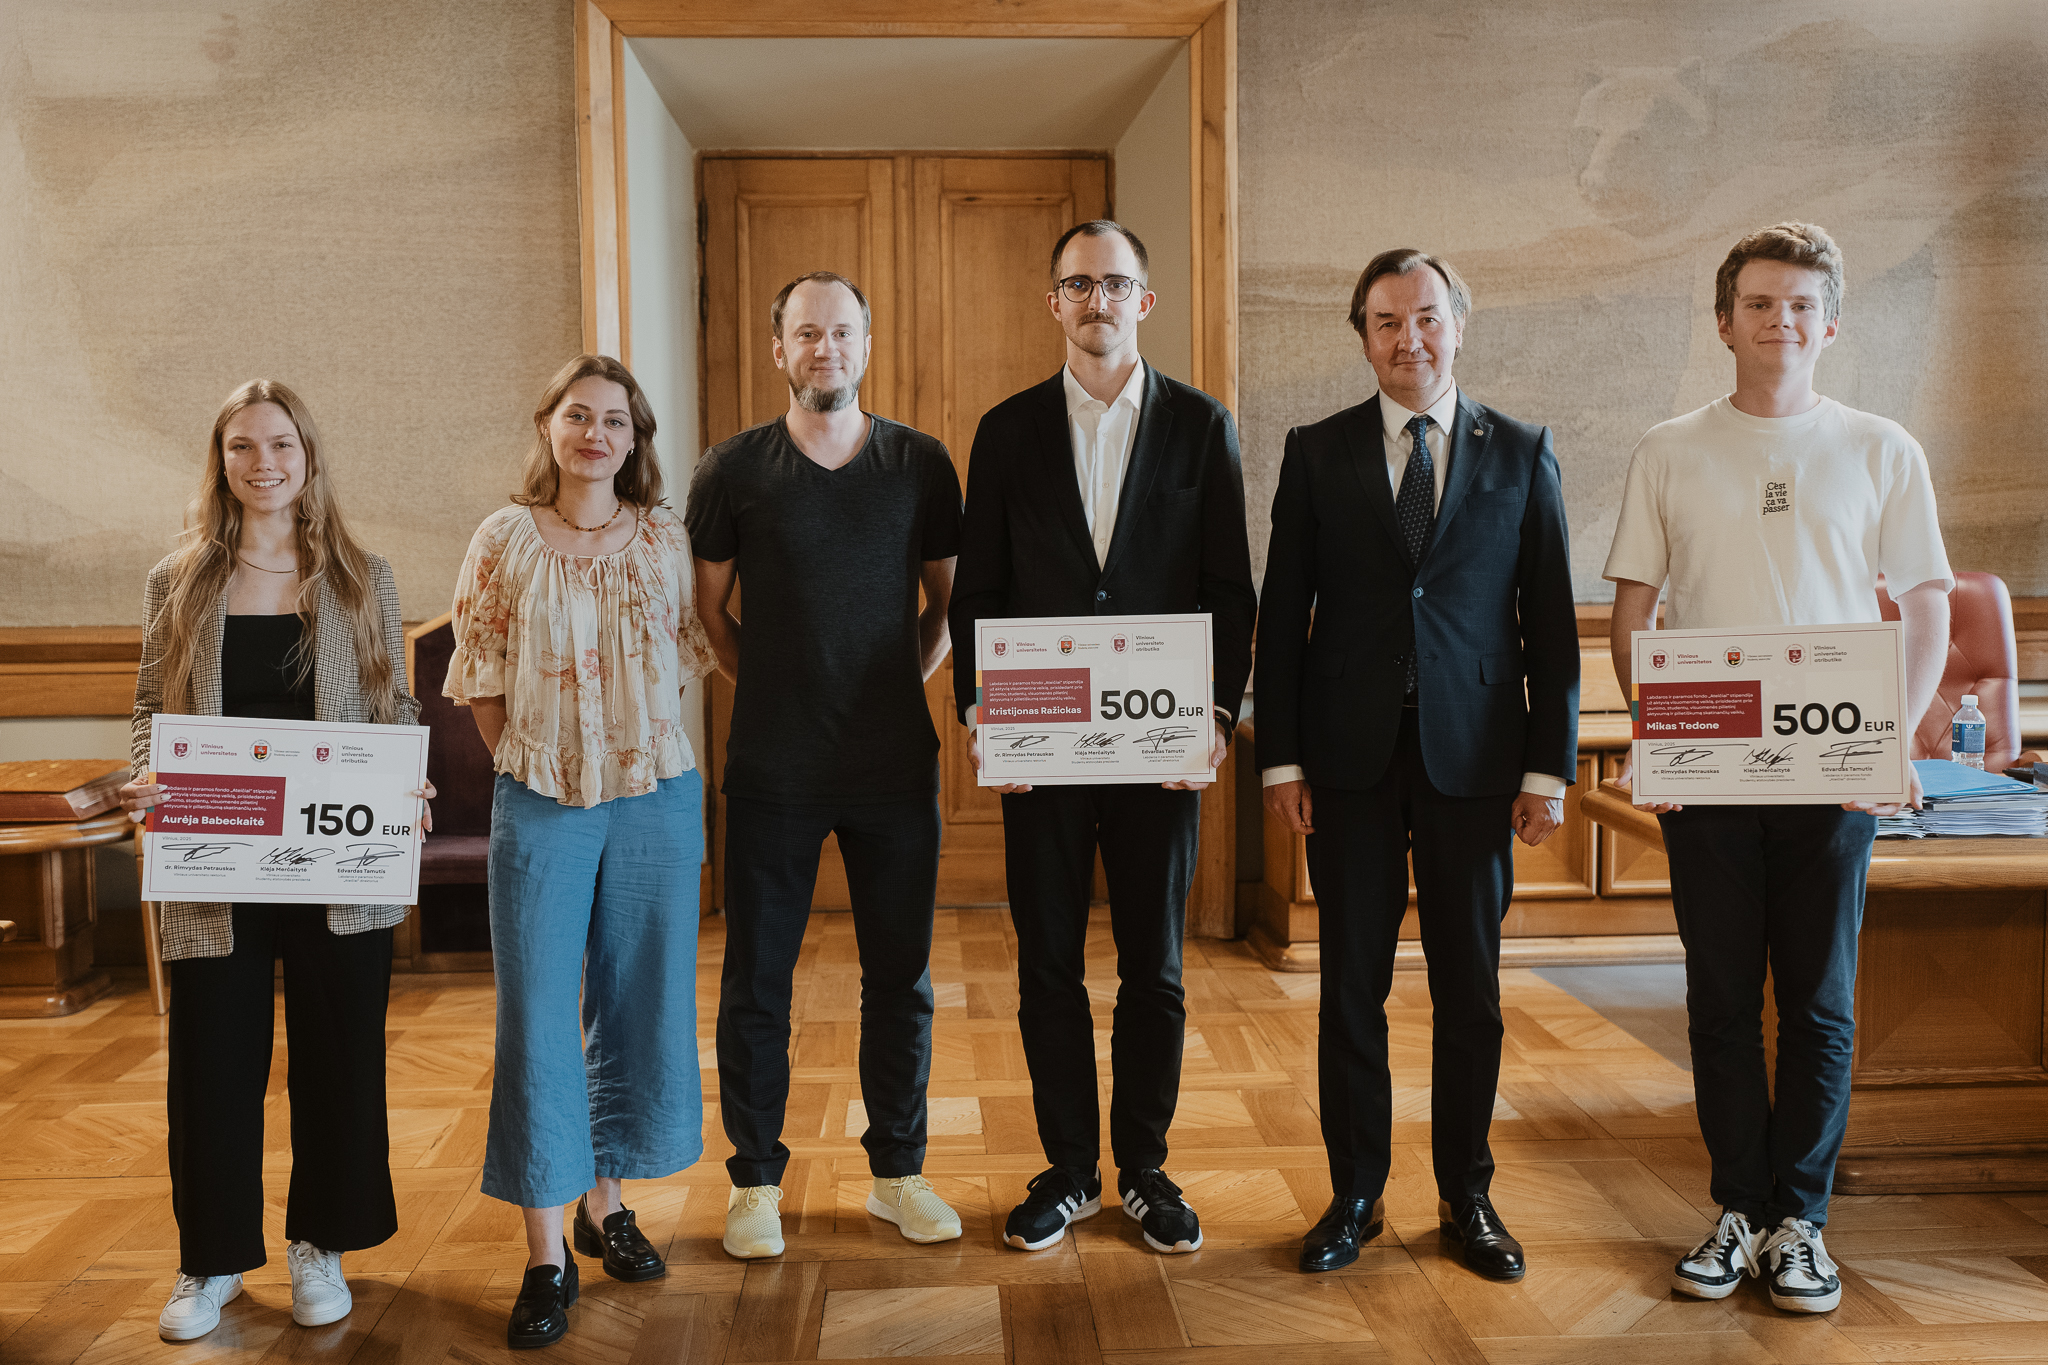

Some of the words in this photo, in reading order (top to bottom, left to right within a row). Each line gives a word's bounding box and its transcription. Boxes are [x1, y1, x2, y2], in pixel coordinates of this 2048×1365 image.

[1765, 489, 1774, 498] la
[1774, 489, 1788, 497] vie
[1762, 504, 1790, 516] passer
[1100, 688, 1176, 720] 500
[1178, 706, 1204, 717] EUR
[989, 706, 1039, 717] Kristijonas
[1041, 706, 1082, 715] Ražickas
[1772, 701, 1861, 736] 500
[1864, 720, 1895, 732] EUR
[1646, 722, 1677, 730] Mikas
[1679, 721, 1720, 730] Tedone
[162, 815, 199, 826] Aurėja
[201, 816, 265, 827] Babeckaitė
[300, 803, 374, 837] 150
[382, 825, 410, 836] EUR
